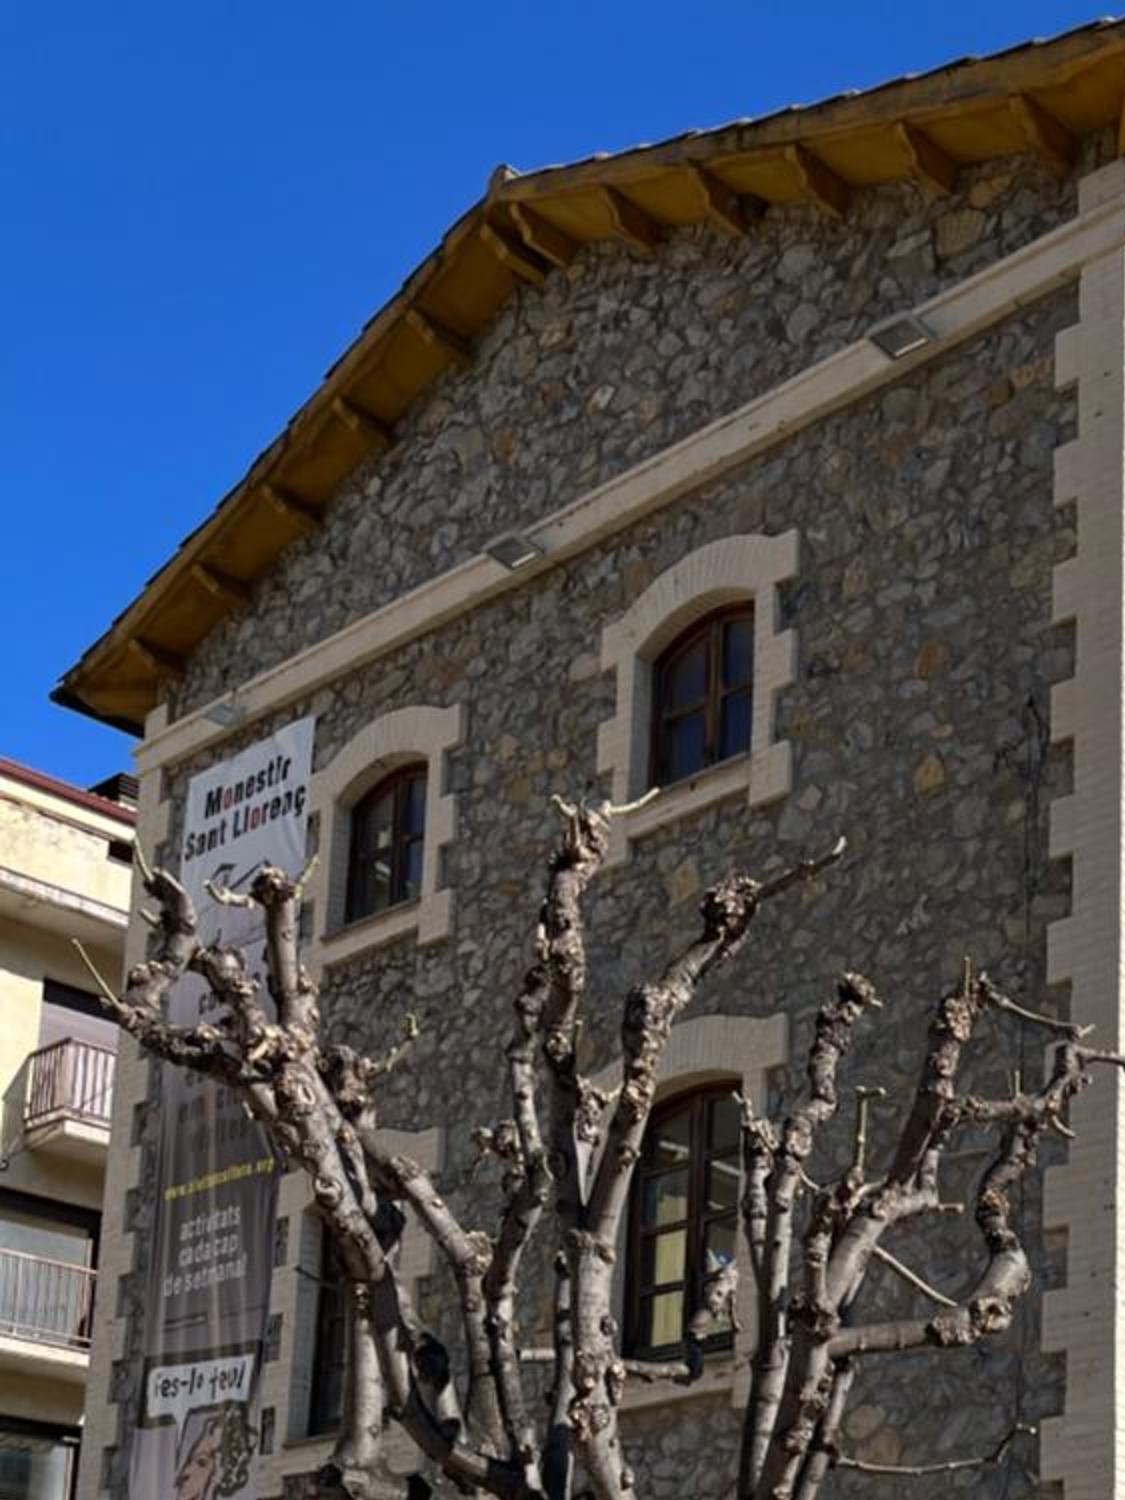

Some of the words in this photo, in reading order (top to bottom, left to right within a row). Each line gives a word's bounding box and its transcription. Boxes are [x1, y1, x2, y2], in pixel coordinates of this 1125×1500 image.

[204, 755, 292, 820] Monestir
[185, 820, 227, 862] Sant
[232, 785, 307, 840] Llorenç
